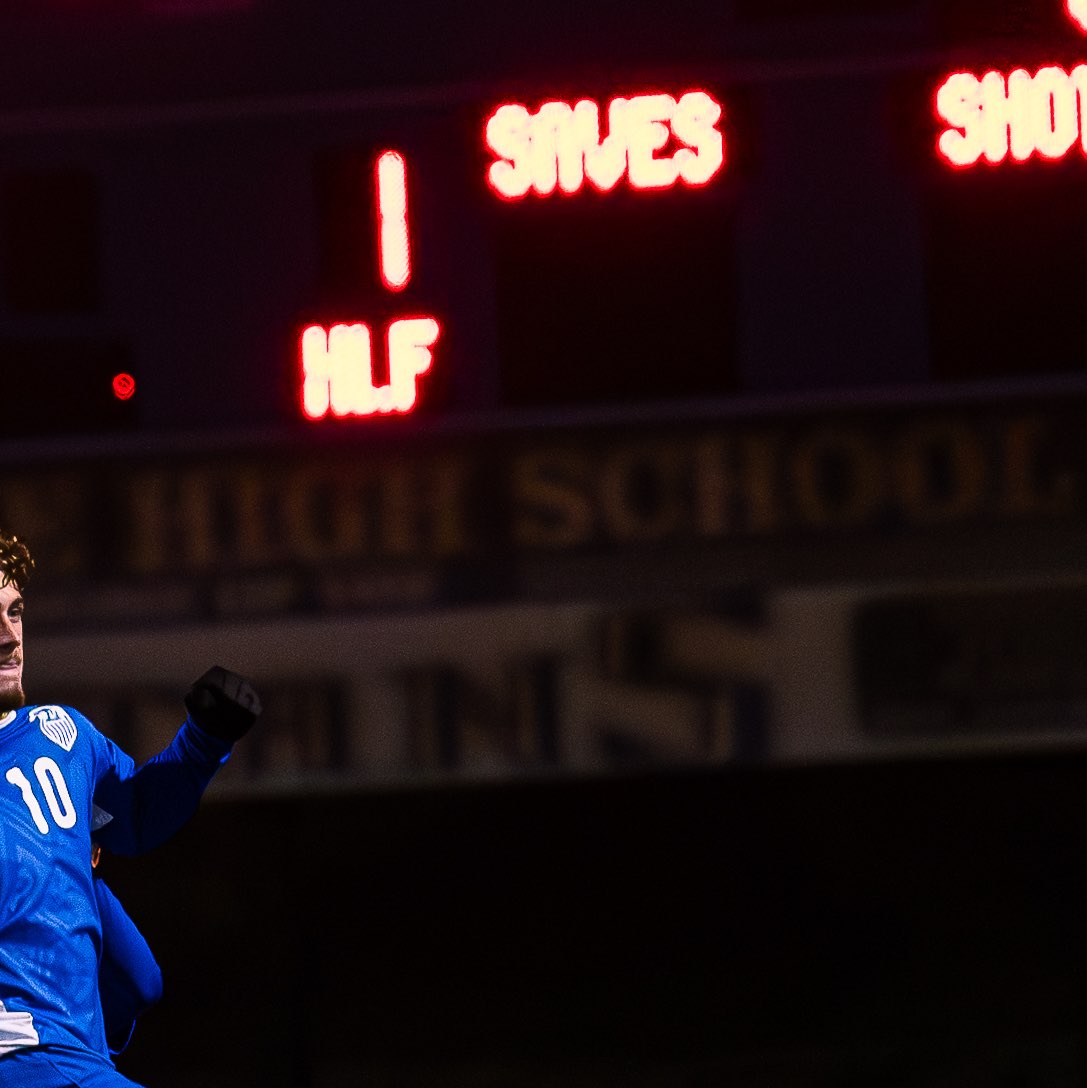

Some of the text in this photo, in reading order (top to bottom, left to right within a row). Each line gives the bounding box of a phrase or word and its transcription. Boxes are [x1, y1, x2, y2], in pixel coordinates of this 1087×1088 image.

[482, 89, 727, 202] SAVES
[298, 315, 443, 420] HLF
[128, 456, 468, 575] HIGH
[512, 405, 1080, 552] SCHOOL
[6, 756, 77, 835] 10
